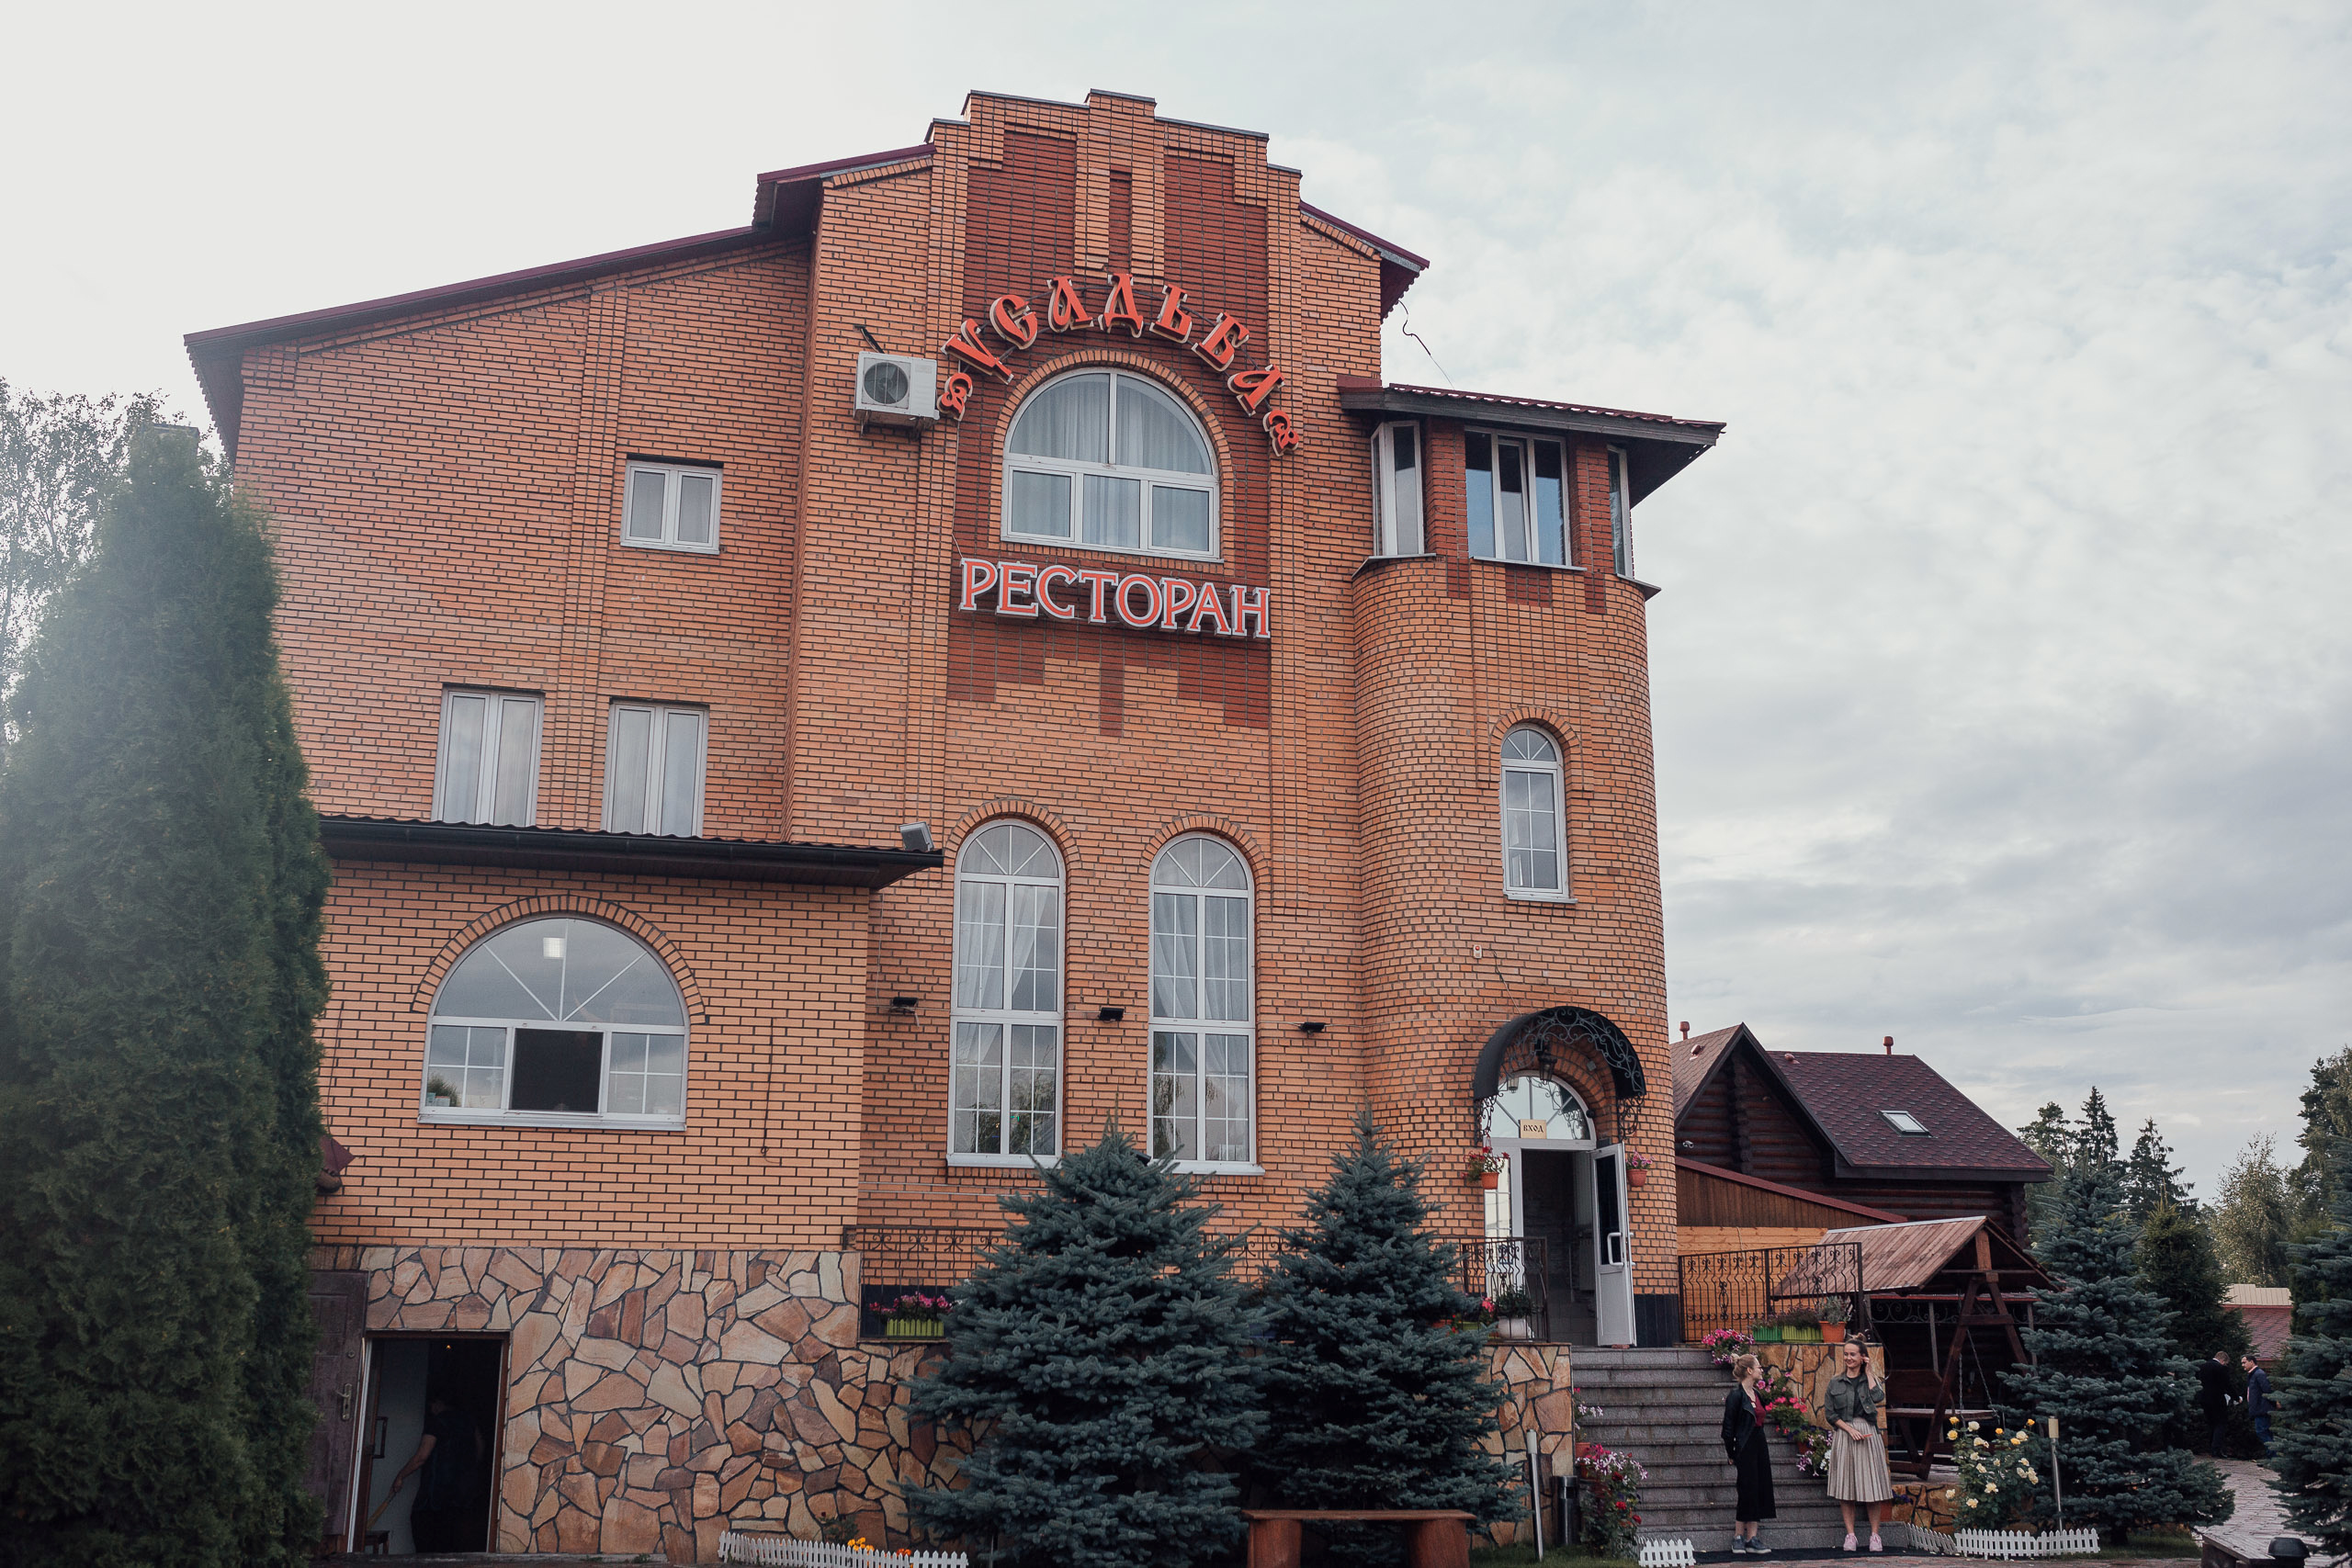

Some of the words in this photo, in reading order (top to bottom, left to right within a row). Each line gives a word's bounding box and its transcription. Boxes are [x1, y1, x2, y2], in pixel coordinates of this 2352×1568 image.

[942, 274, 1285, 416] УСАДЬБА
[960, 558, 1271, 638] РЕСТОРАН
[1522, 1124, 1544, 1134] ВХОД
